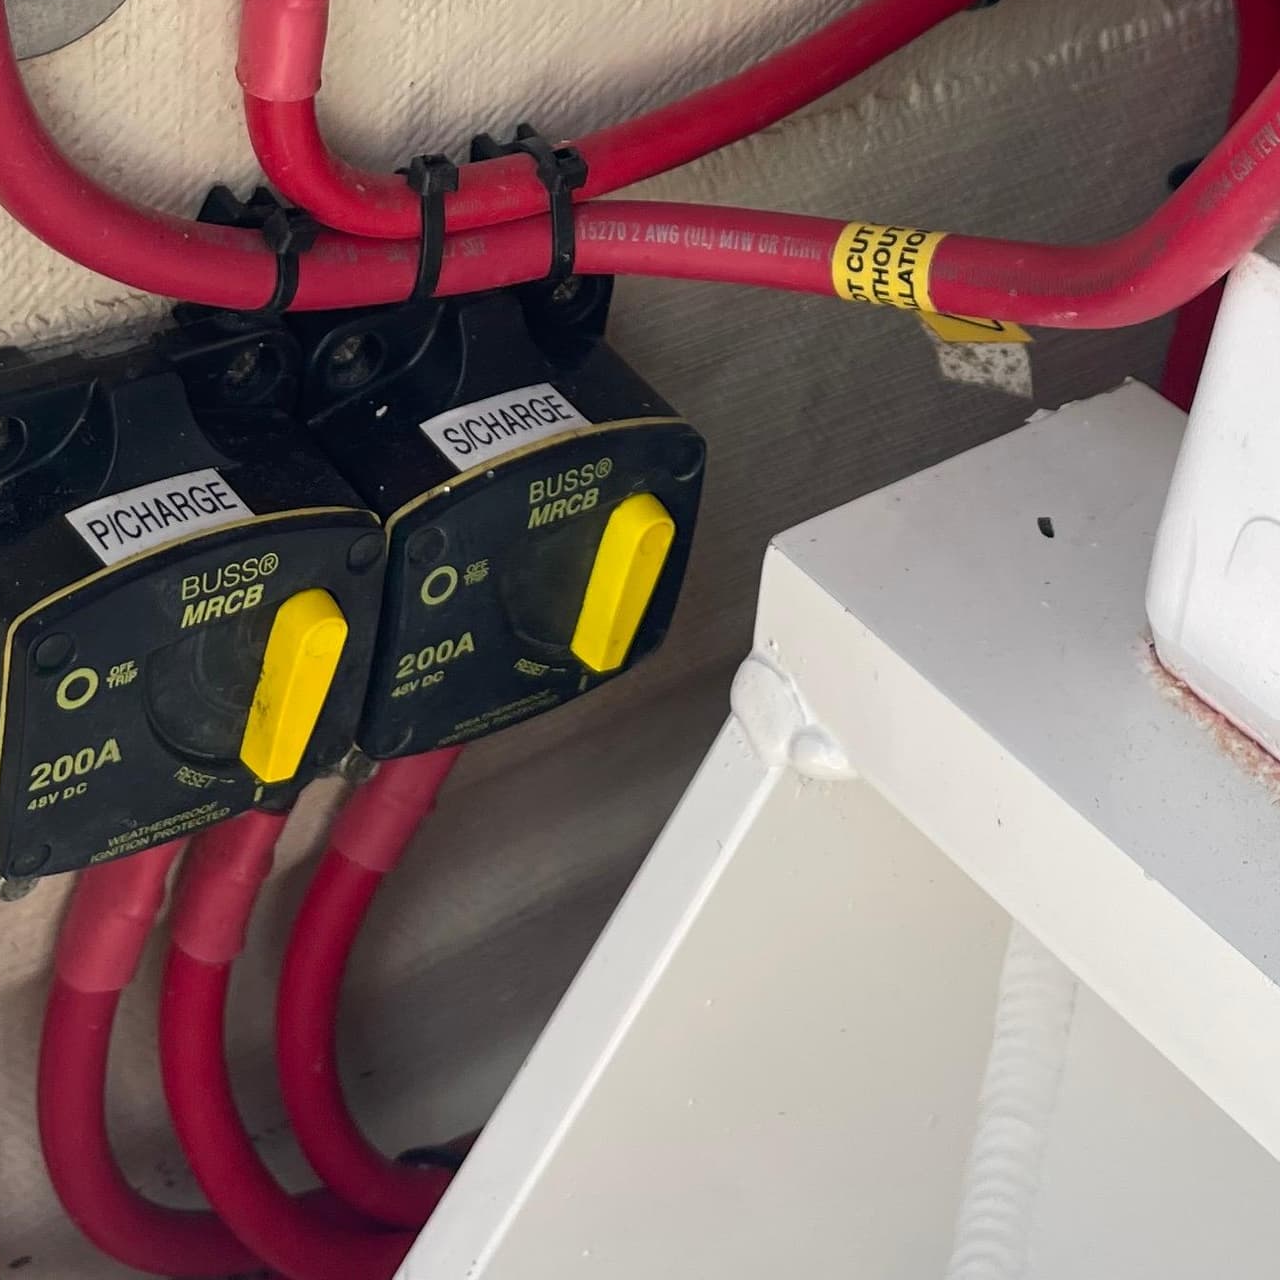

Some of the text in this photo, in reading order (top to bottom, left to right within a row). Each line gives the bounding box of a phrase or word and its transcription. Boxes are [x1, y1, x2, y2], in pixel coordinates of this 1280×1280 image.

[645, 223, 680, 245] AWG
[846, 225, 875, 273] CUT
[442, 395, 574, 455] S/CHARGE
[86, 481, 238, 551] P/CHARGE
[527, 487, 600, 530] MRCB
[180, 583, 265, 629] MRCB
[395, 631, 475, 679] 200A
[422, 670, 445, 687] DC
[28, 737, 122, 792] 200A
[27, 782, 88, 811] 48V DC
[90, 806, 231, 863] IGNITION PROTECTED
[107, 801, 218, 847] WEATHERPROOF
